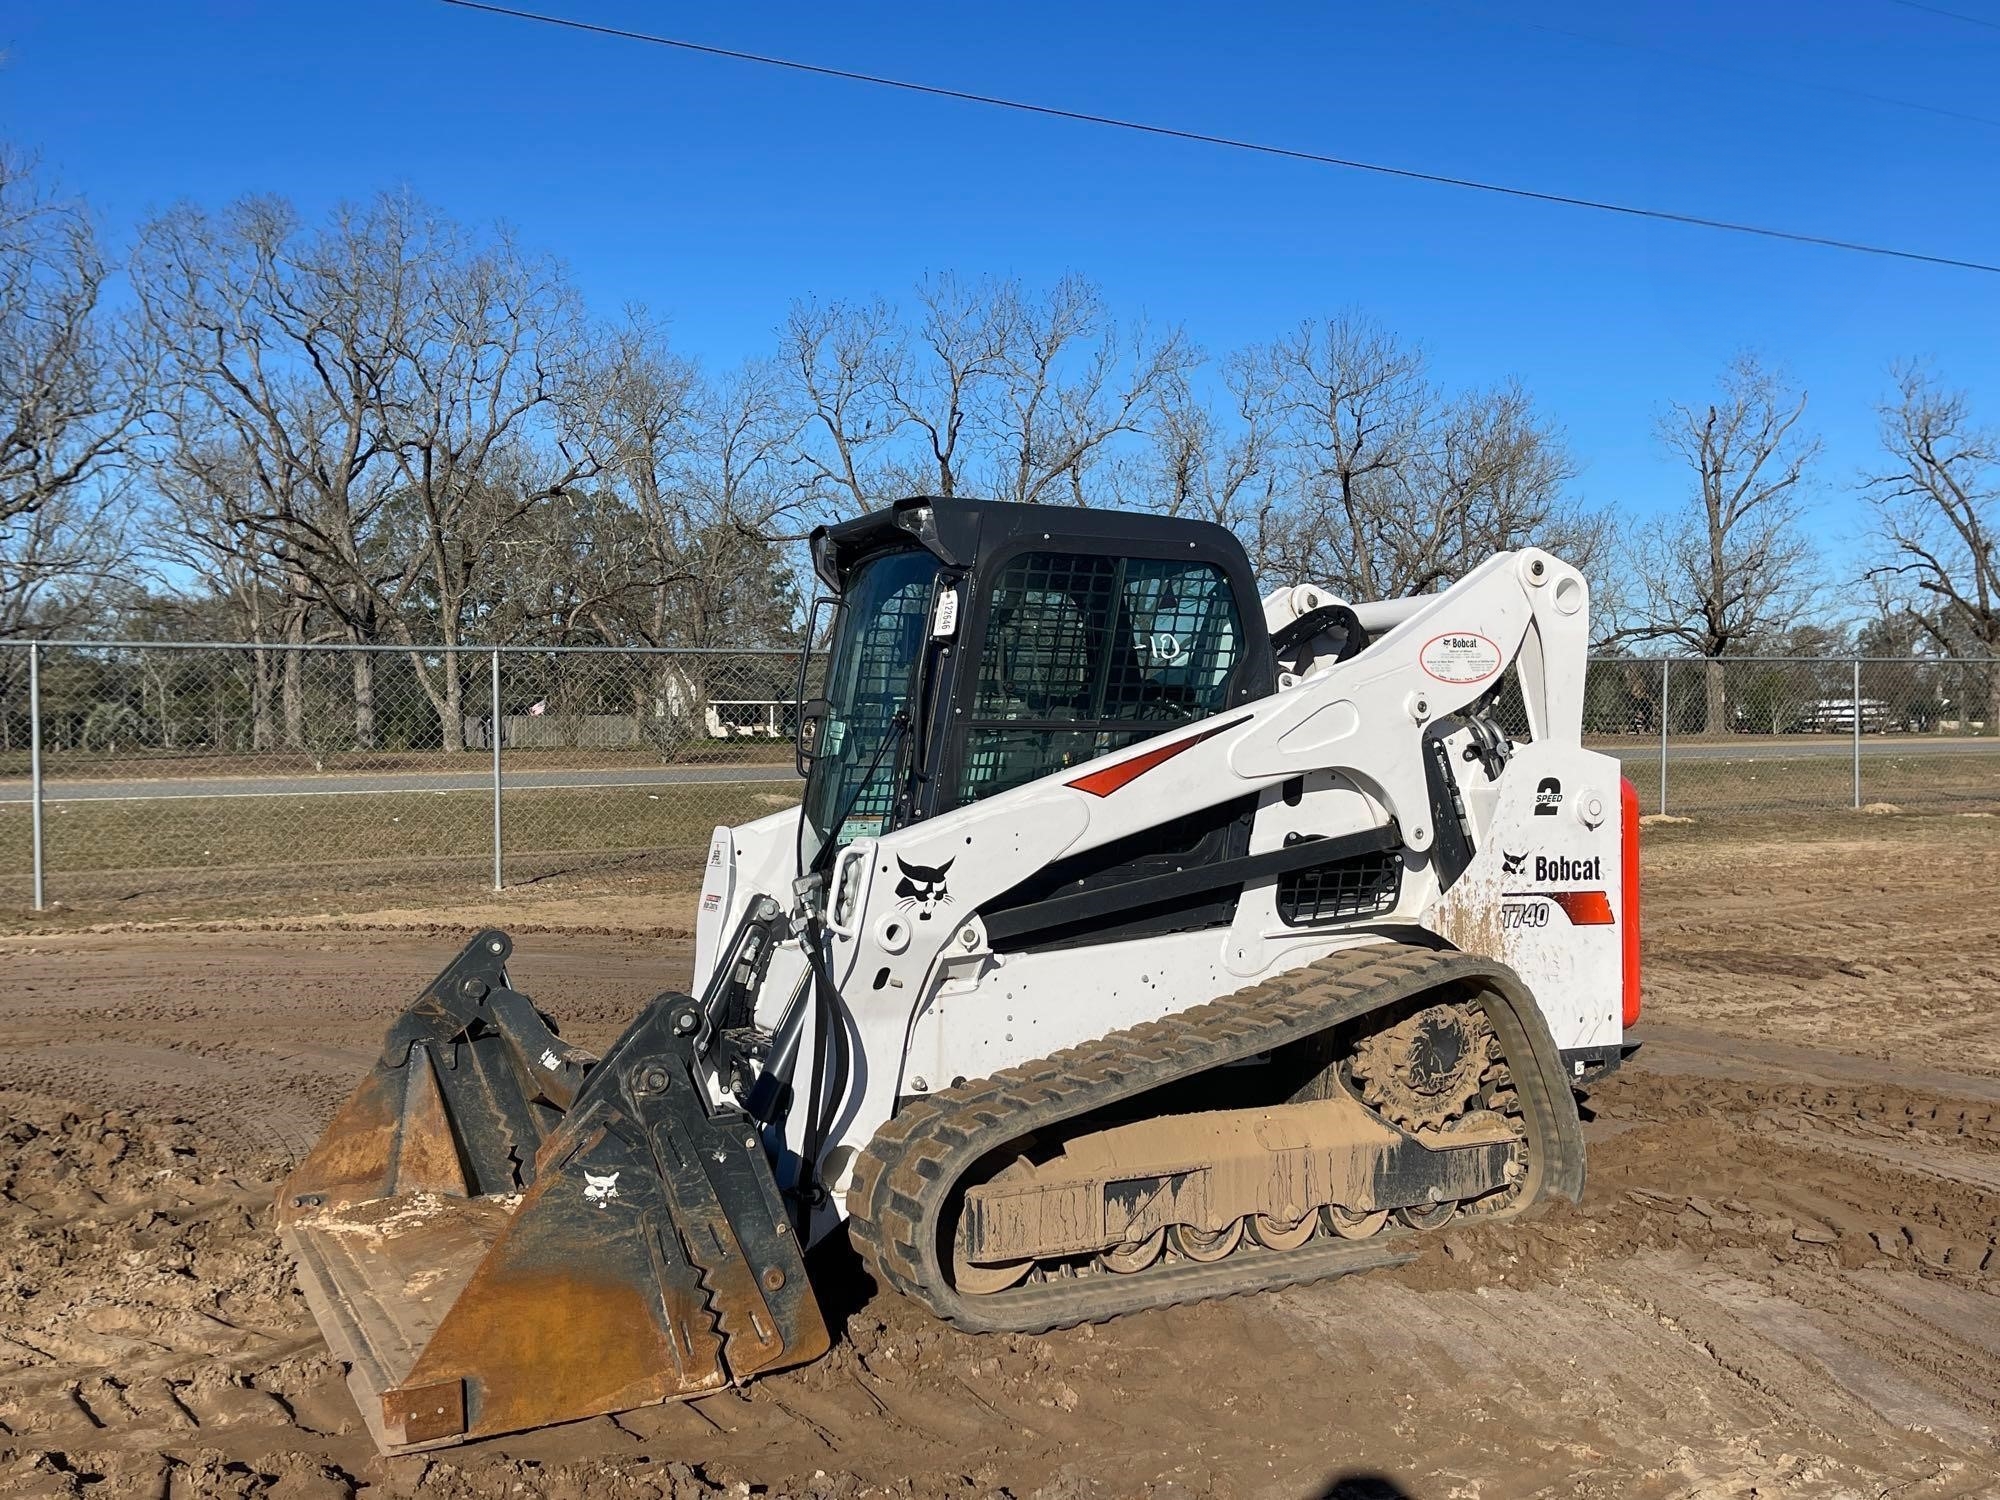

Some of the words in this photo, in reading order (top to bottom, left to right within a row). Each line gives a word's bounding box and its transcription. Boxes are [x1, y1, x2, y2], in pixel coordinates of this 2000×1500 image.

[941, 601, 954, 630] 122646
[1452, 638, 1477, 648] Bobcat
[1534, 777, 1561, 816] 2
[1536, 794, 1563, 803] SPEED
[1535, 856, 1600, 881] Bobcat
[1502, 903, 1550, 928] T740
